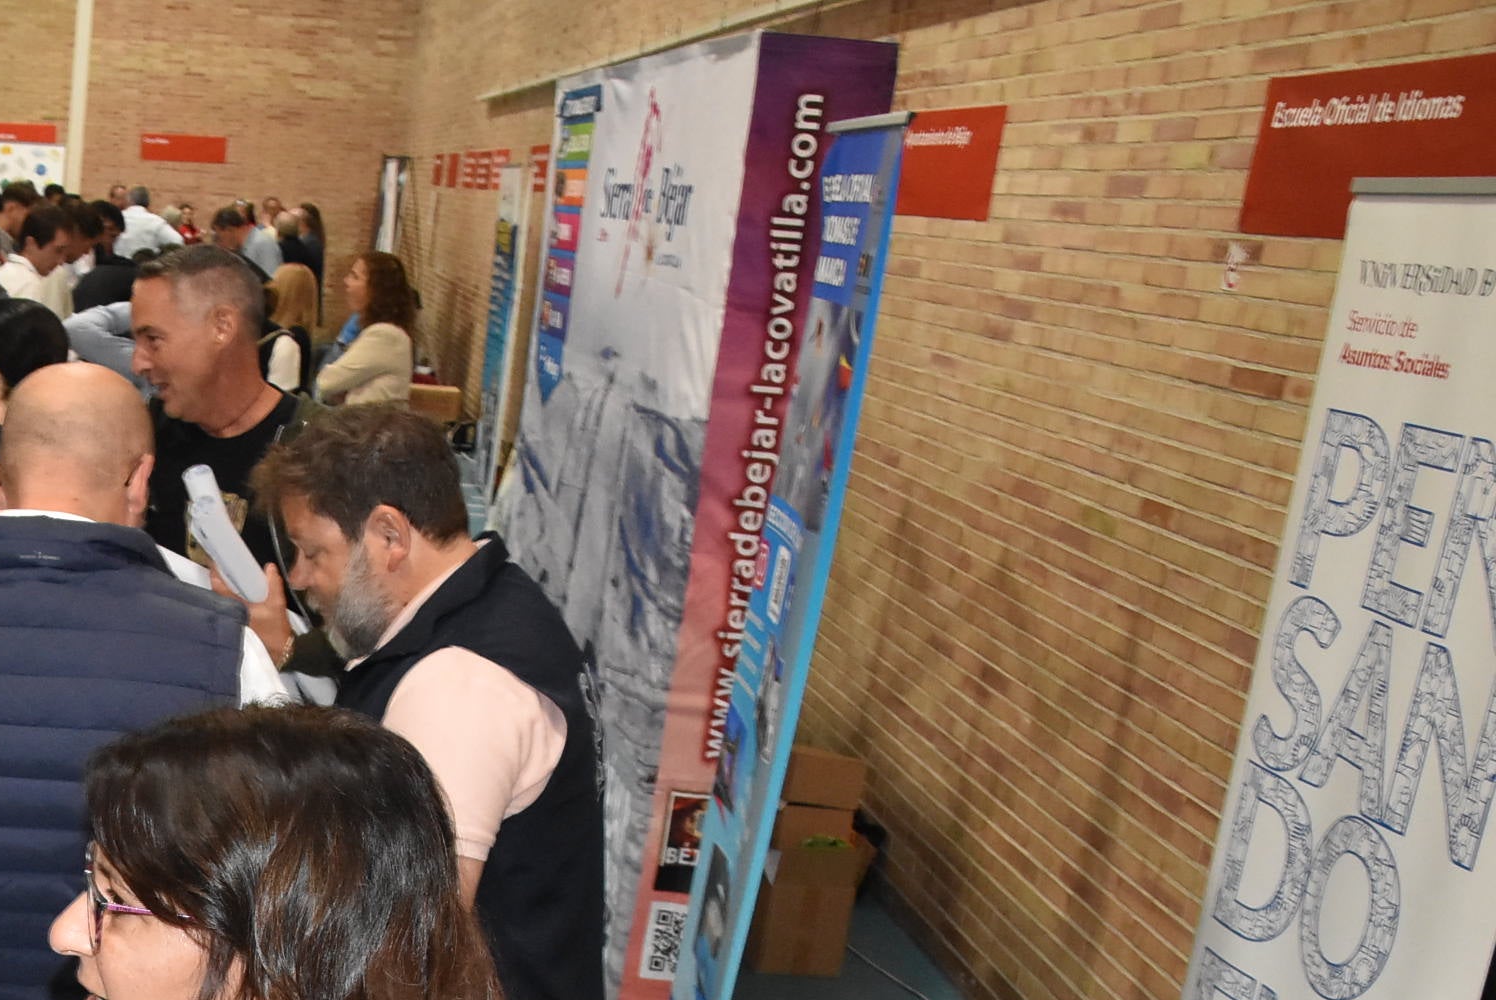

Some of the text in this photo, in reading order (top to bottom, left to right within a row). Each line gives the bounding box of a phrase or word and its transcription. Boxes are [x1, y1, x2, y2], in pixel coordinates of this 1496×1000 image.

[1271, 89, 1465, 129] Escuela Oficial de Idiomas
[1360, 260, 1478, 297] UNIVERSIDAD
[1347, 309, 1418, 339] Servicio de
[1339, 342, 1452, 380] Asuntos Sociales
[704, 93, 825, 759] wwwsierradebejar-lacovatilla.com
